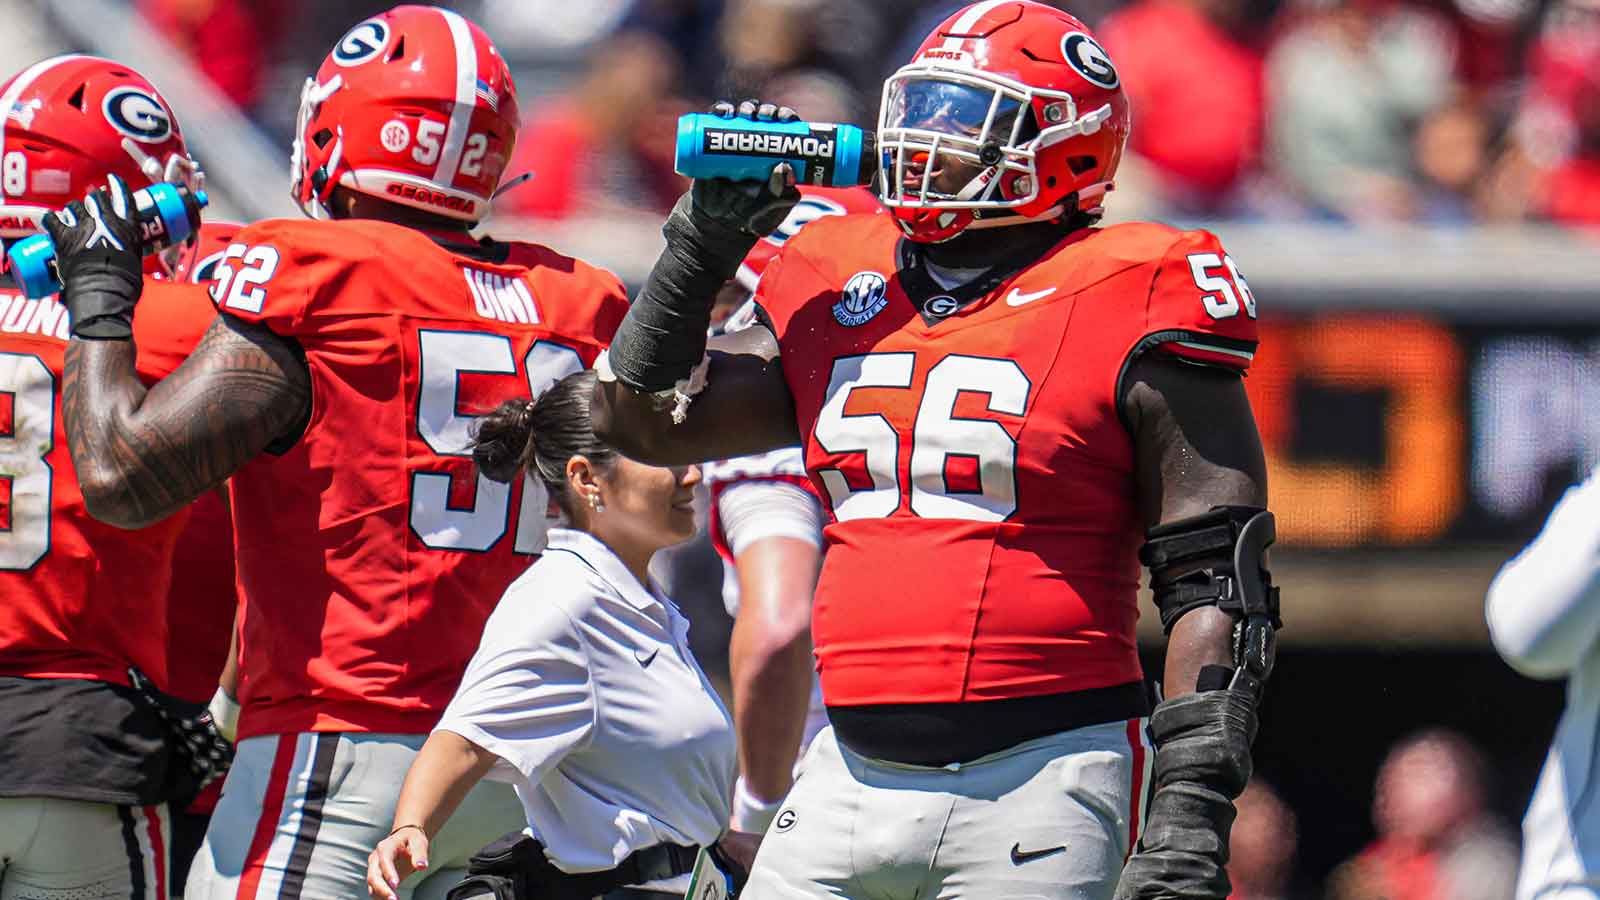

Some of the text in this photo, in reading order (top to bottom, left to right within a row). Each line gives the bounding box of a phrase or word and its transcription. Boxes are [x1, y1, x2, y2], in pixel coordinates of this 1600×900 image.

[1072, 37, 1114, 80] G
[116, 91, 170, 134] G
[387, 182, 475, 214] GEORGIA
[209, 243, 280, 314] 52
[928, 297, 957, 315] G
[812, 352, 1032, 523] 56
[776, 809, 796, 829] G
